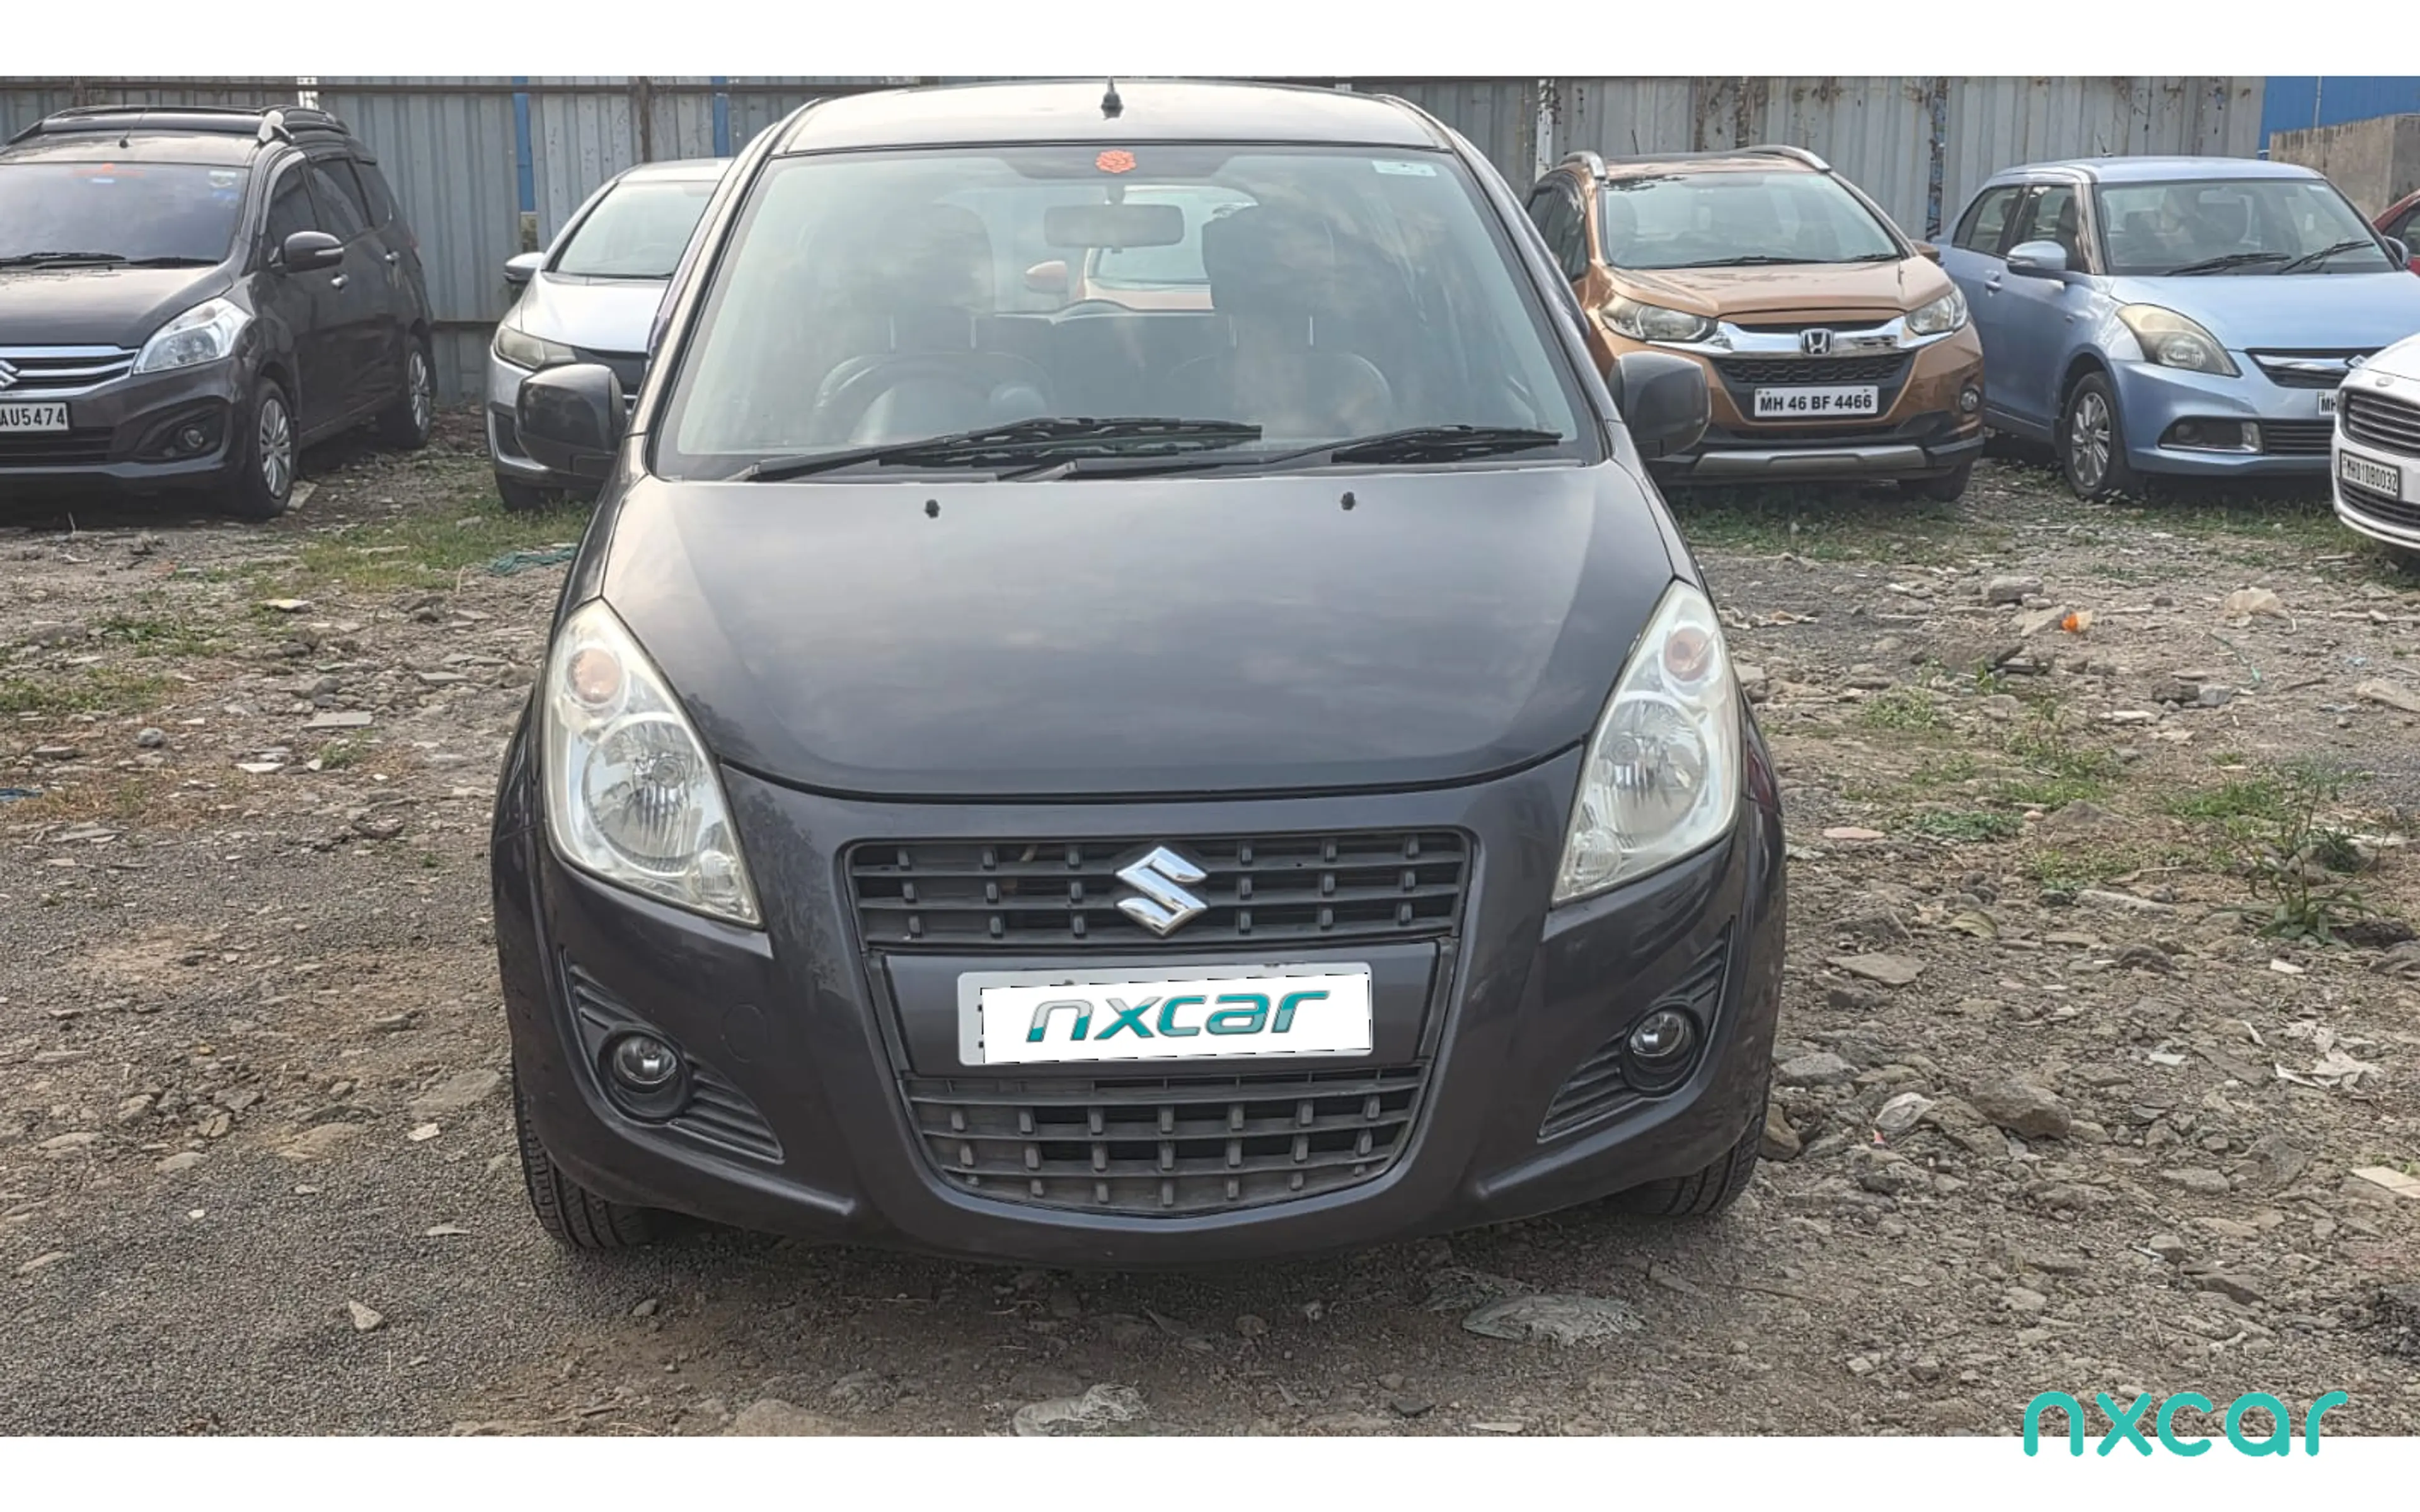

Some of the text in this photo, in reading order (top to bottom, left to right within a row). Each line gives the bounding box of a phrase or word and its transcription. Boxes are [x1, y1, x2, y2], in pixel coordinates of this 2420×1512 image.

[1760, 394, 1872, 411] MH 46 BF 4466
[0, 408, 65, 427] AU5474
